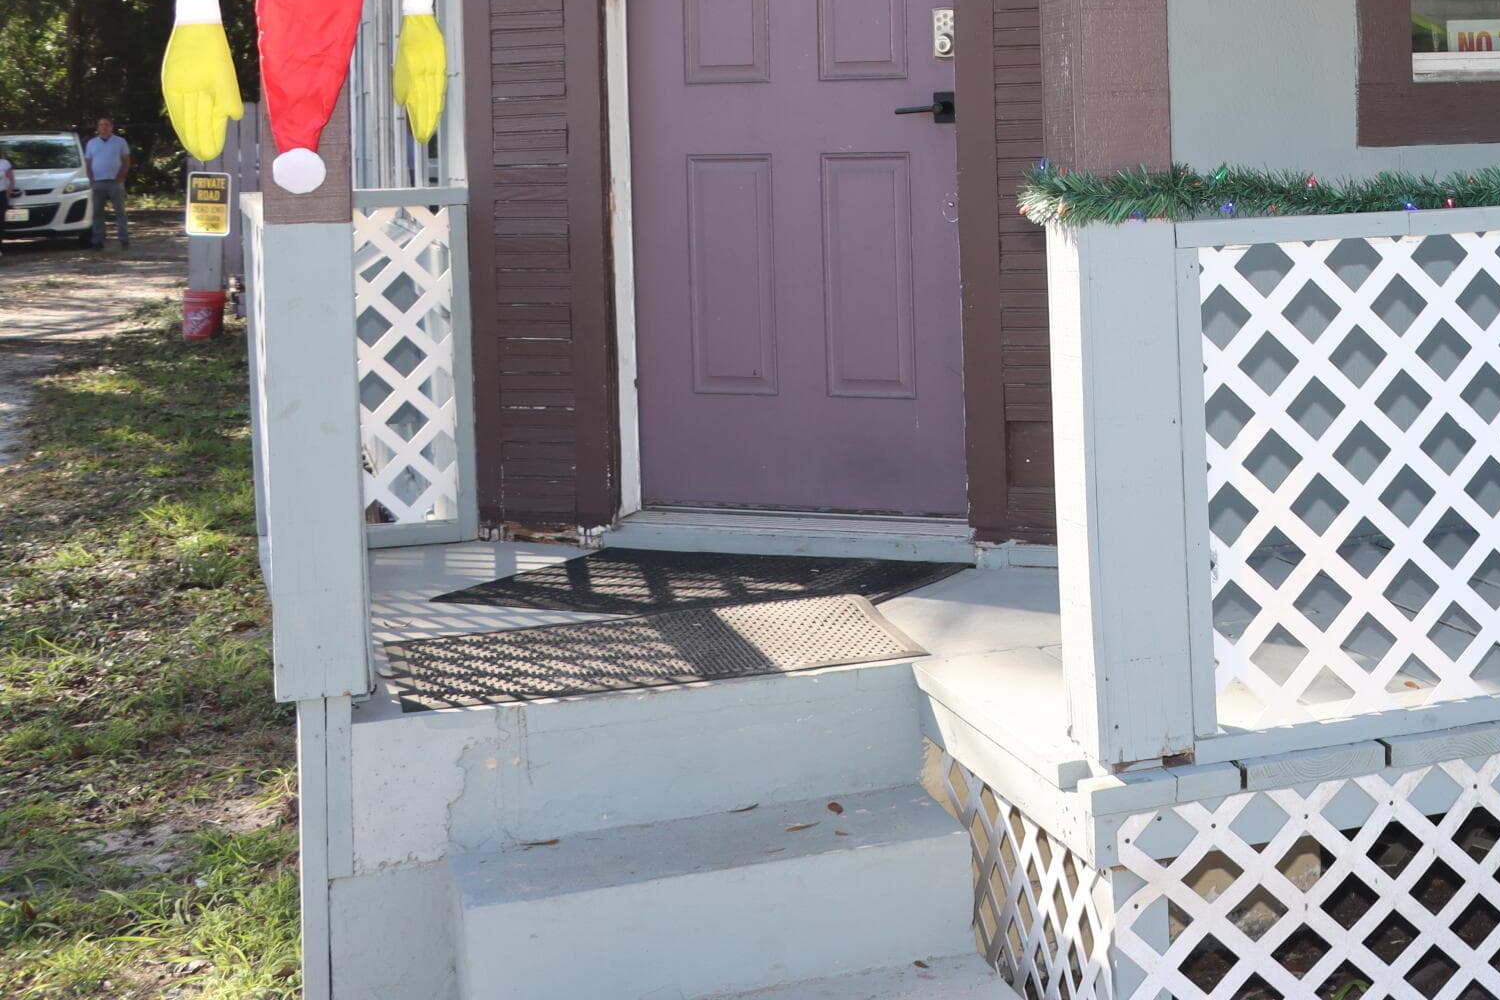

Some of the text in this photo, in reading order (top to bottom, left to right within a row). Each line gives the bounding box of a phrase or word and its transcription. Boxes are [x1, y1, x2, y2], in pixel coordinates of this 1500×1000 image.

[1458, 31, 1493, 52] NO
[192, 177, 226, 189] PRIVATE
[197, 190, 220, 201] ROAD
